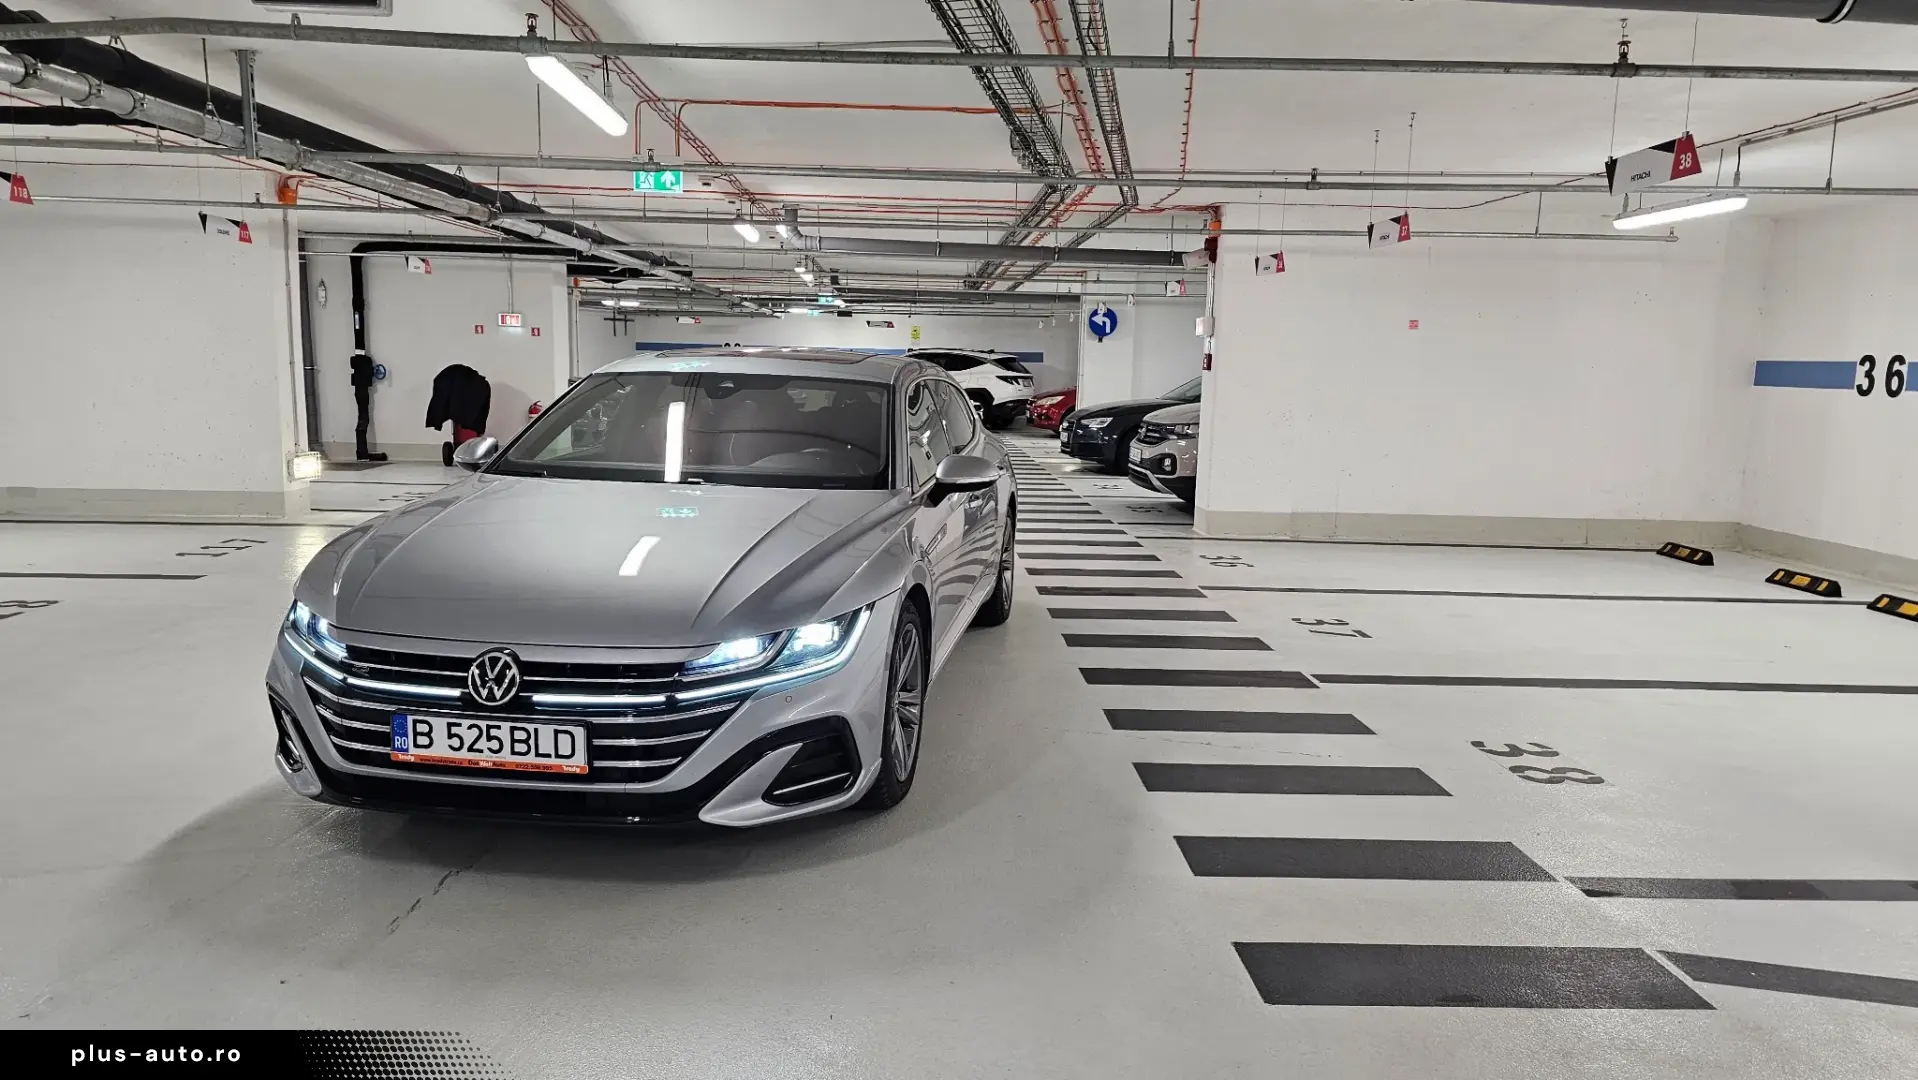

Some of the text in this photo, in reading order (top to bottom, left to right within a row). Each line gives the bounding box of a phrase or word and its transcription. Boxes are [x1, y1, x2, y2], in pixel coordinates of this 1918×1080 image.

[1679, 152, 1692, 170] 38
[1630, 170, 1651, 182] HITACHI
[13, 186, 28, 199] 118
[1856, 354, 1907, 399] 36
[1291, 617, 1373, 639] 37
[394, 735, 409, 750] RO
[412, 718, 576, 760] B 525 BLD
[1470, 740, 1605, 785] 38
